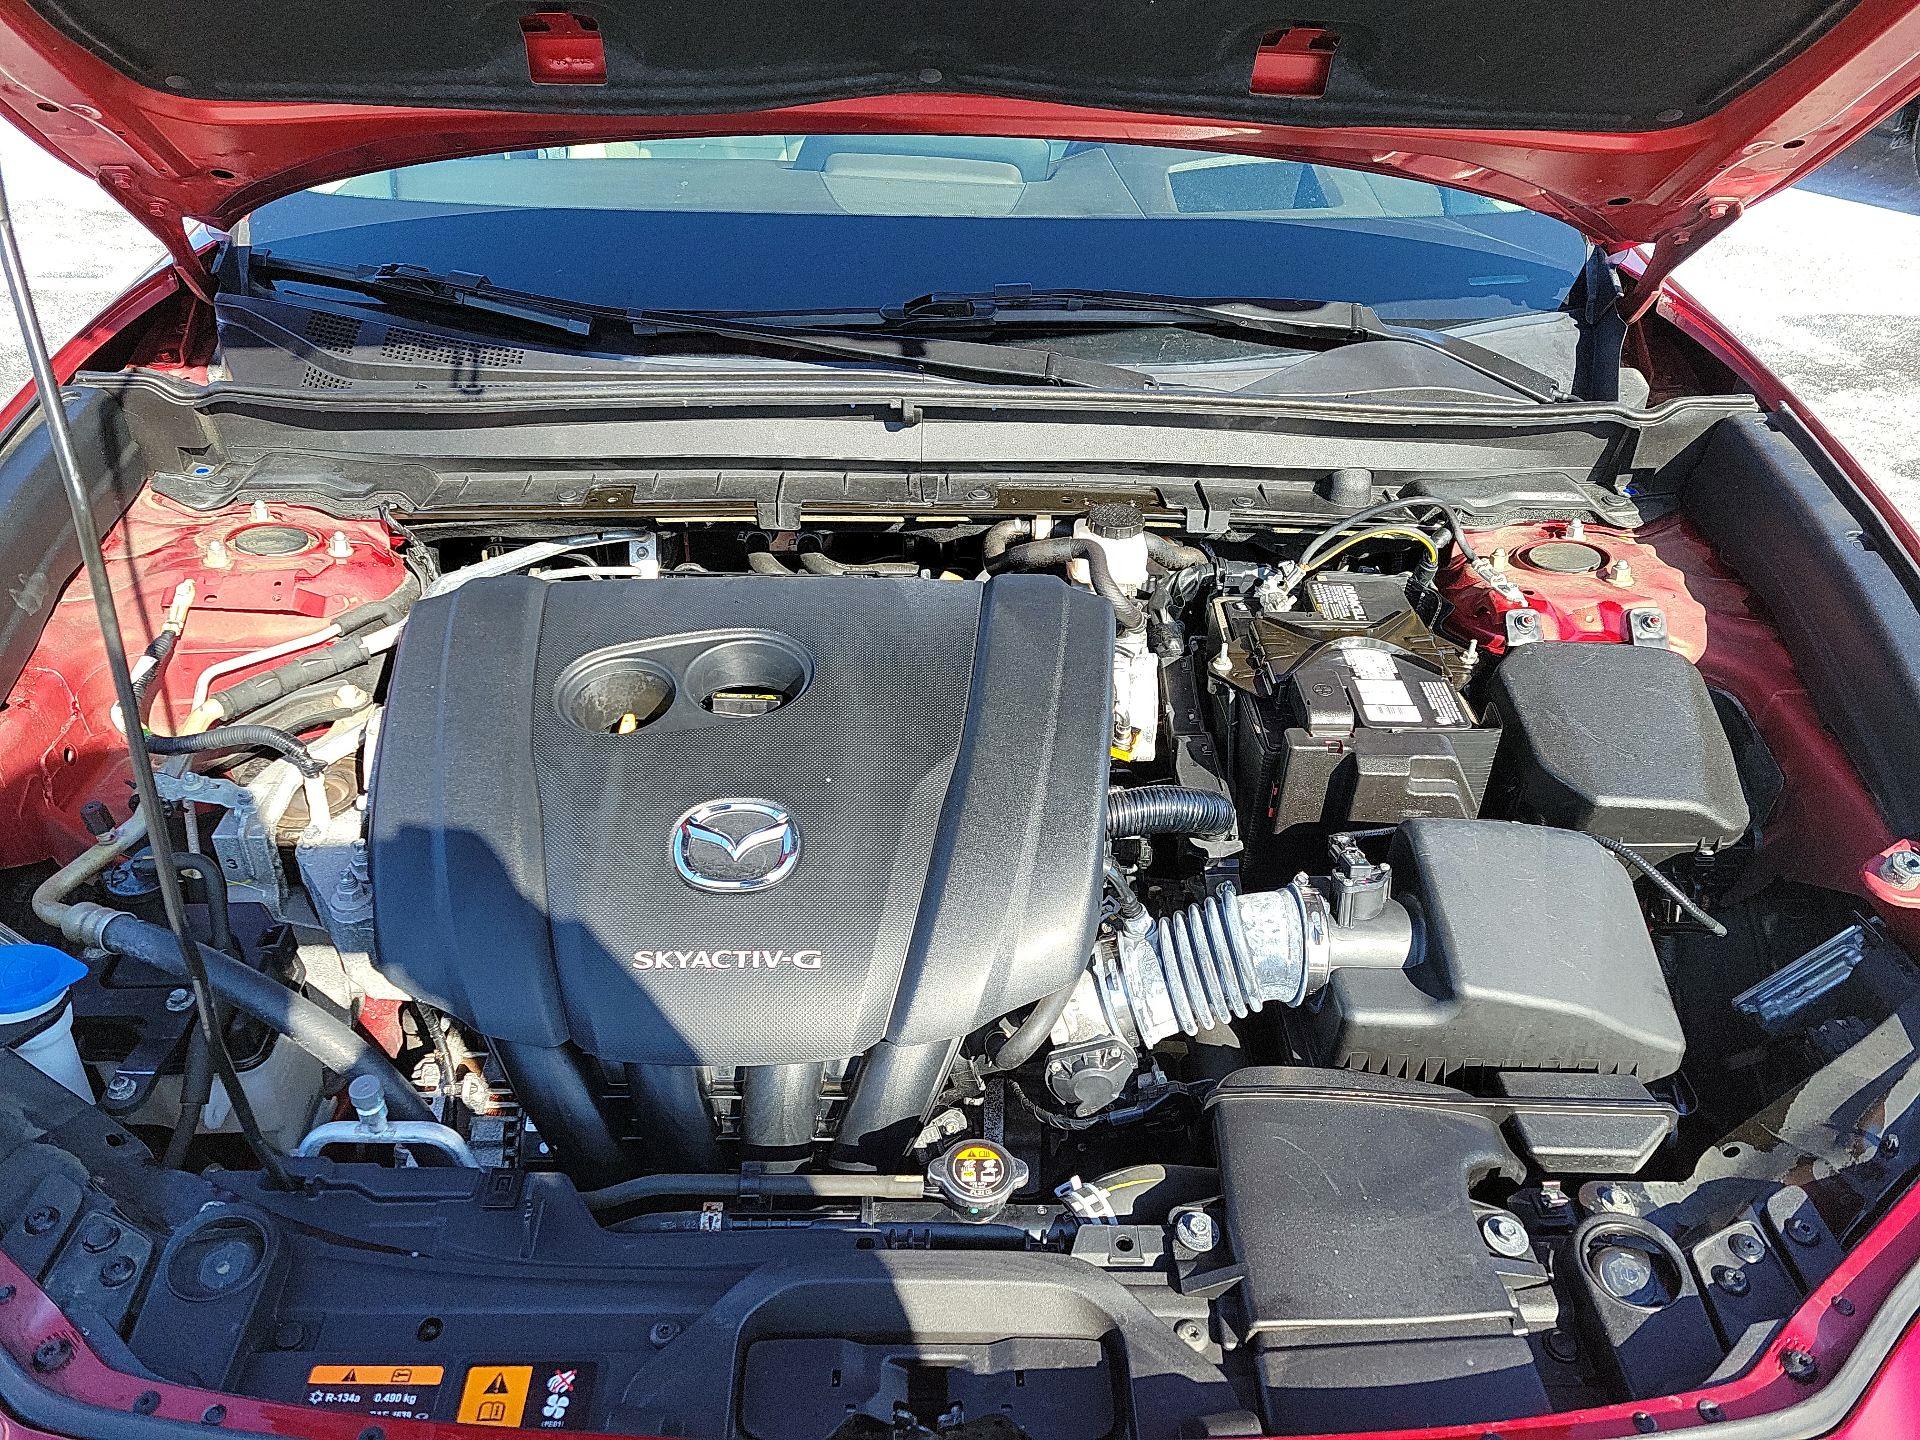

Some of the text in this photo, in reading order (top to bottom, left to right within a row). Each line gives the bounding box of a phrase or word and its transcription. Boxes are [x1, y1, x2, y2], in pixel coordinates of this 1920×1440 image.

[632, 949, 823, 971] SKYACTIV-G
[325, 1392, 361, 1403] R-134a
[403, 1392, 417, 1405] kg
